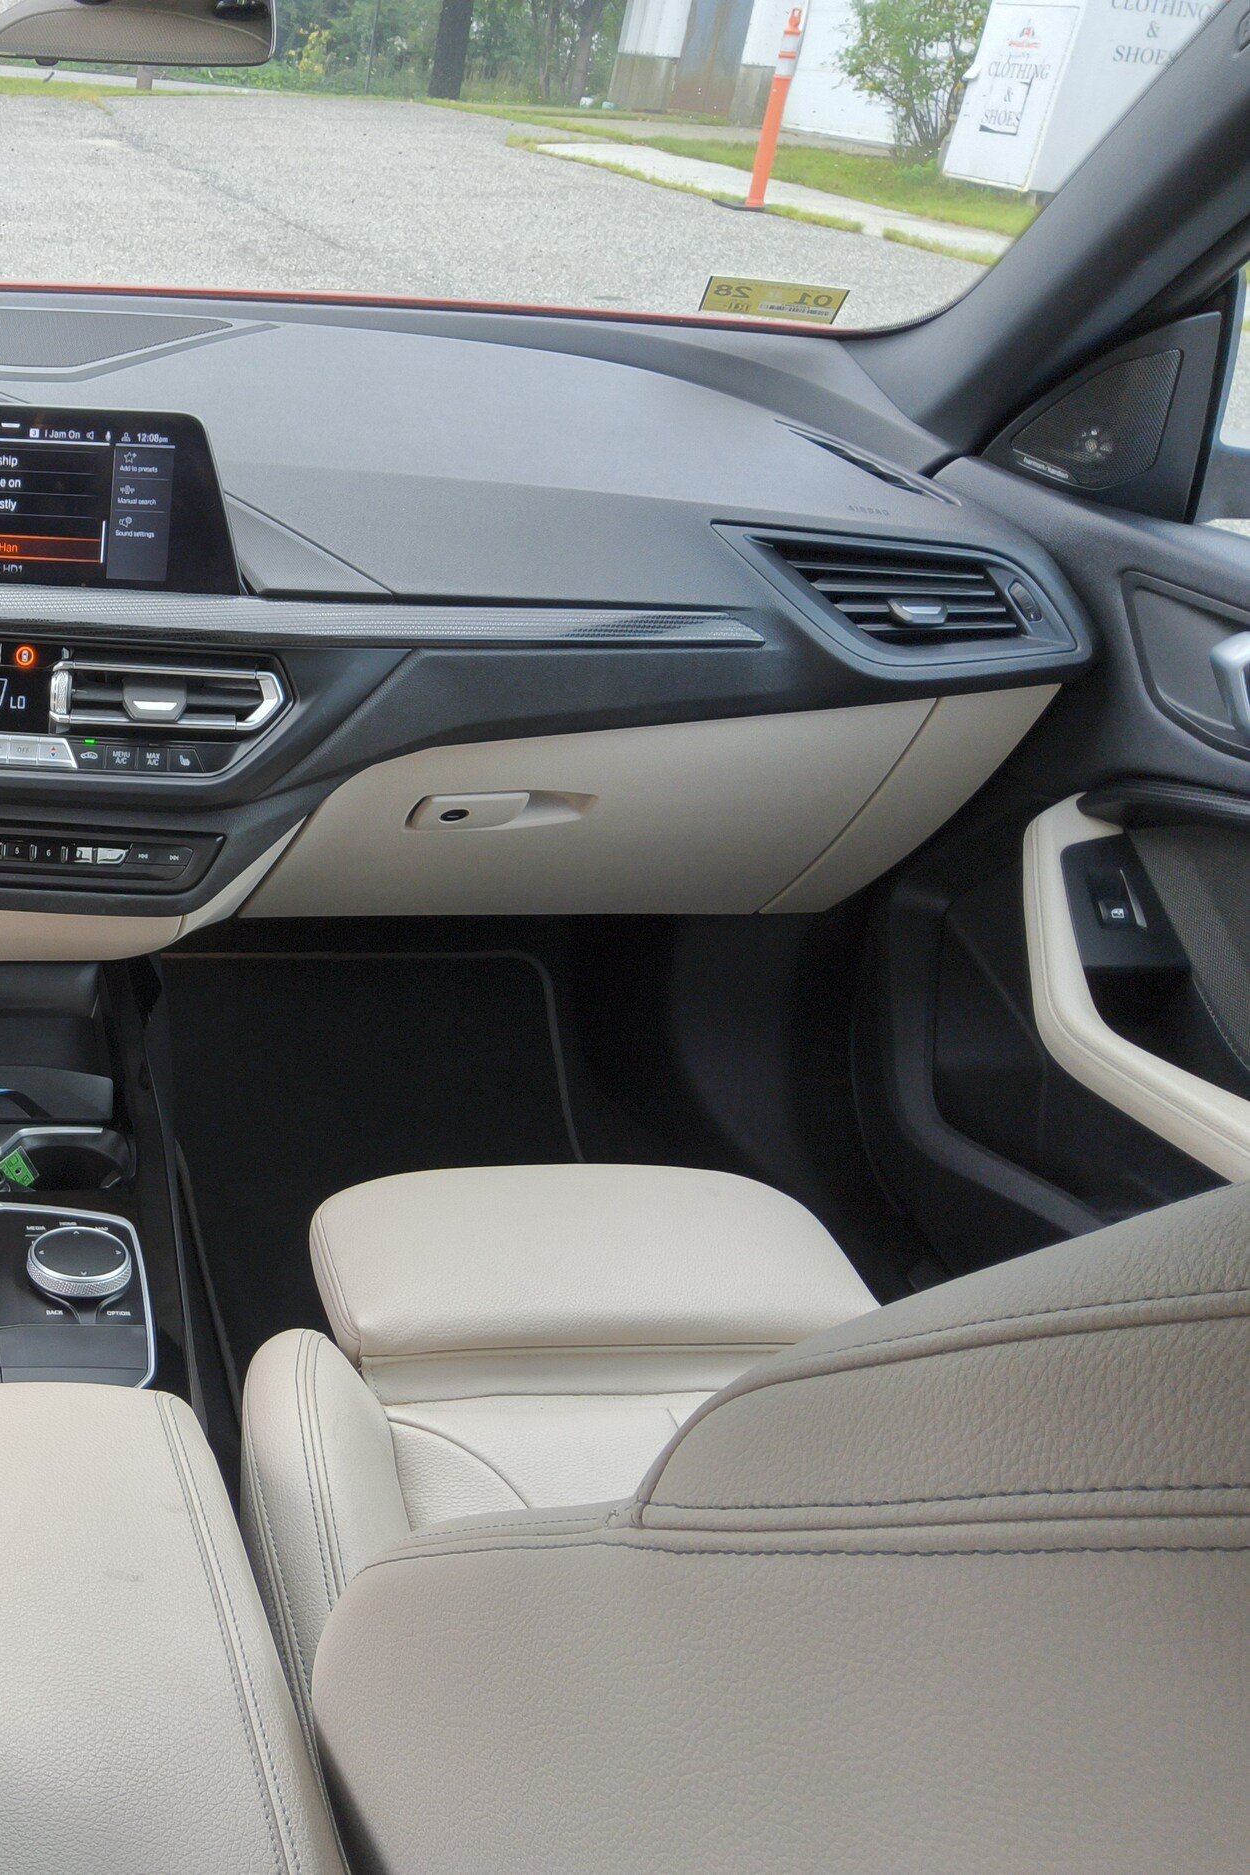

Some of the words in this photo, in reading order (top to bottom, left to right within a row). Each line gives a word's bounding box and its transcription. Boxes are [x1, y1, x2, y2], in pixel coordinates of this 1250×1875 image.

[1146, 20, 1161, 38] &
[988, 61, 1050, 79] CLOTHING
[1003, 86, 1014, 102] &
[981, 108, 1022, 128] SHOES
[50, 430, 67, 439] Jam
[68, 430, 81, 439] On
[9, 479, 22, 488] on
[10, 695, 26, 709] LO
[112, 750, 131, 758] MENU
[115, 757, 127, 765] A/C
